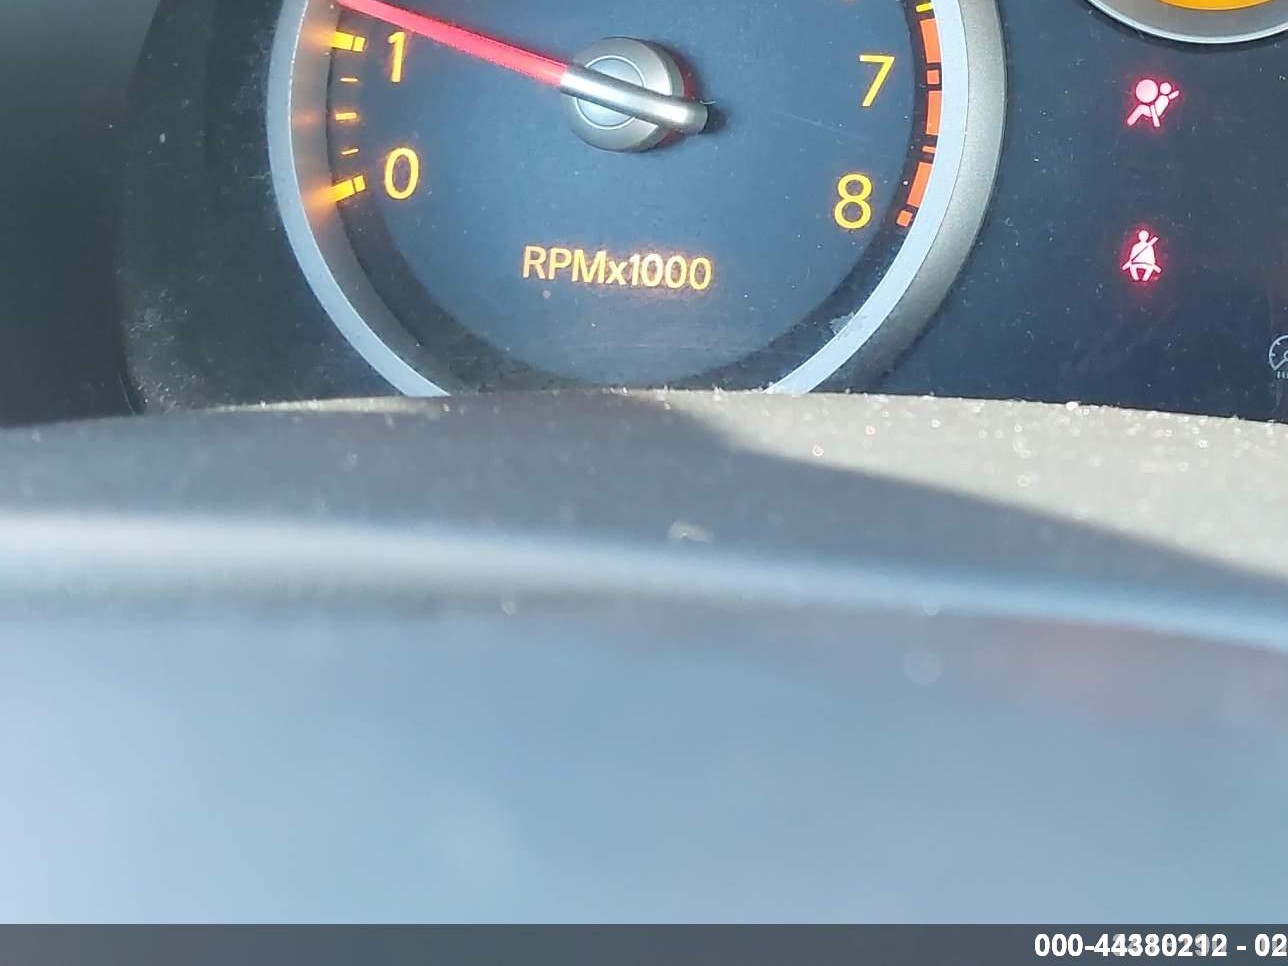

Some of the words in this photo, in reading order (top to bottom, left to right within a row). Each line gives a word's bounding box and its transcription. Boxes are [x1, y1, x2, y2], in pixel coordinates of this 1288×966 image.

[387, 32, 406, 82] 1
[859, 55, 894, 107] 7
[384, 148, 420, 200] 0
[835, 175, 871, 230] 8
[522, 246, 712, 290] RPMx1000
